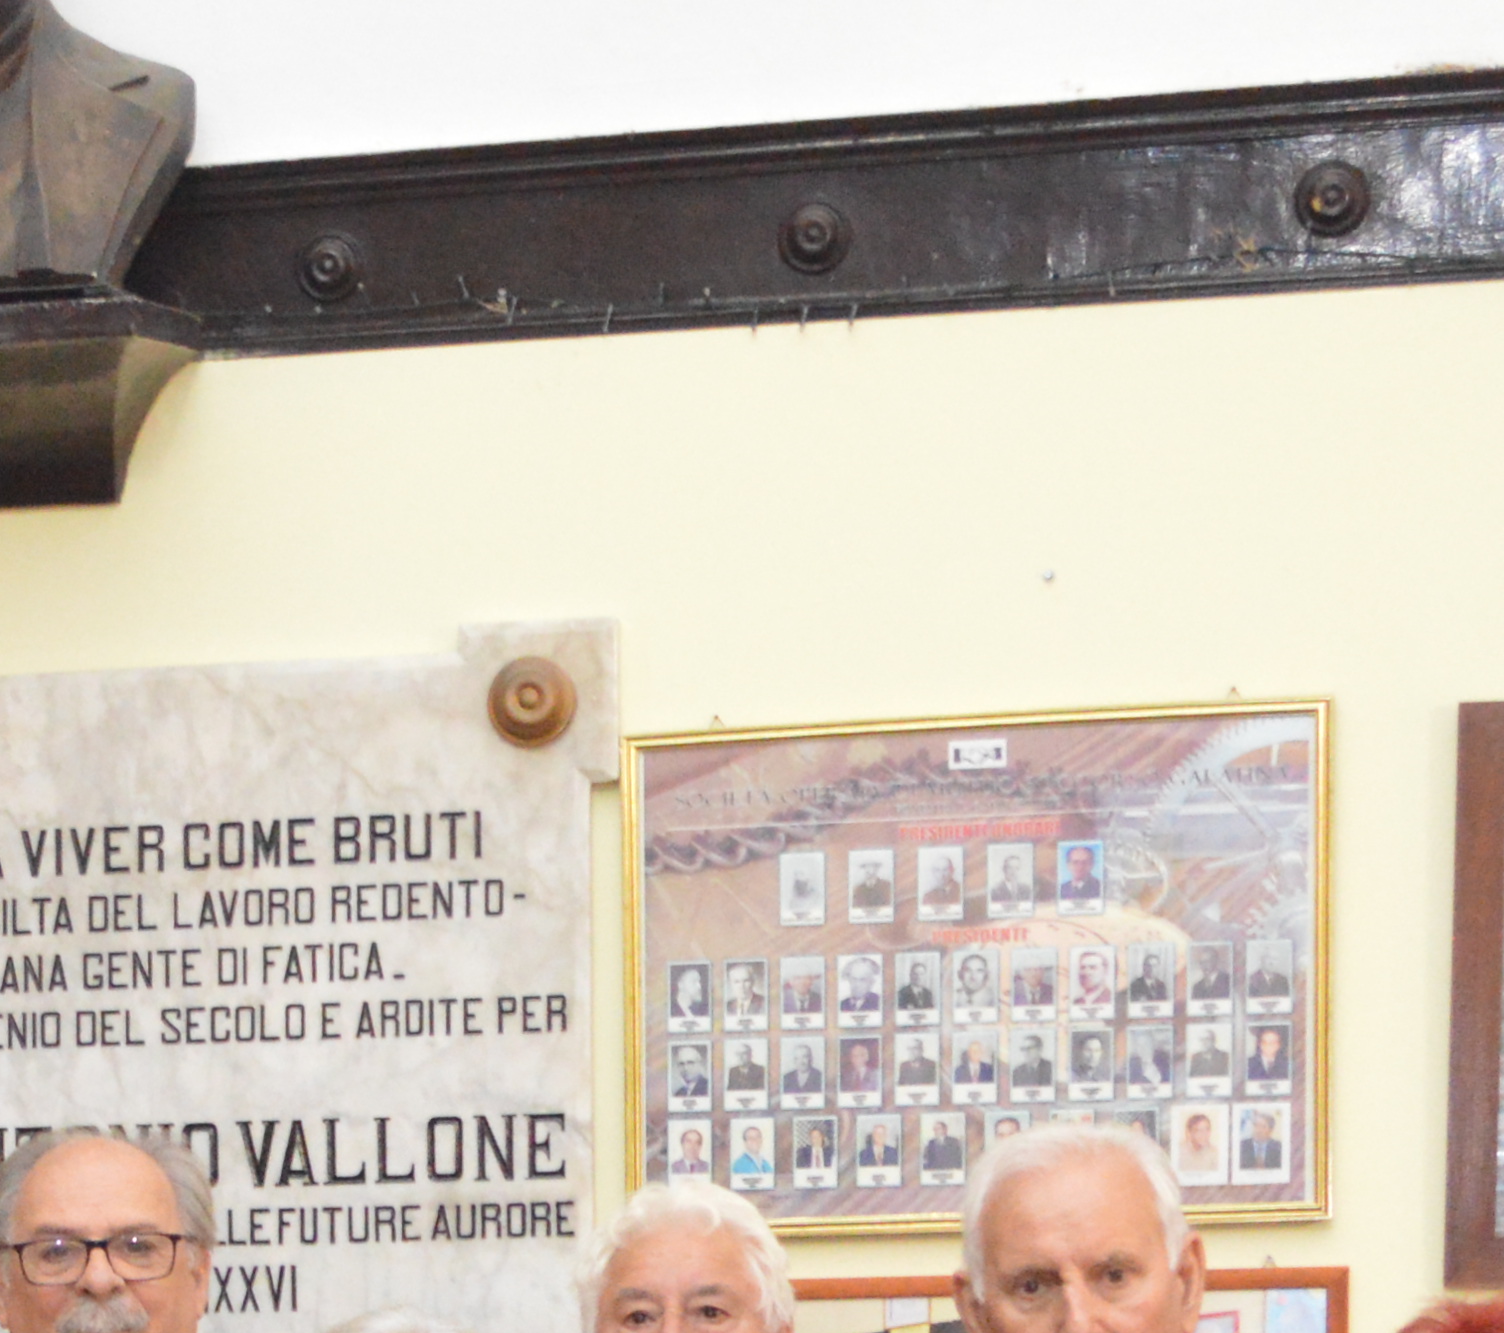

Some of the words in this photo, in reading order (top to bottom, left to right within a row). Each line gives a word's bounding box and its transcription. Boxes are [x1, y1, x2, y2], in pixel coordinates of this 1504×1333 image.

[21, 824, 166, 878] VIVER
[182, 817, 316, 871] COME
[332, 811, 484, 866] BRUTI
[88, 895, 158, 934] DEL
[173, 887, 316, 930] LAVORO
[82, 948, 202, 991] GENTE
[217, 947, 248, 986] DI
[76, 1009, 145, 1047] DEL
[160, 1004, 307, 1045] SECOLO
[321, 1003, 342, 1040] E
[356, 998, 483, 1039] ARDITE
[497, 994, 567, 1035] PER
[235, 1113, 567, 1188] VALLONE
[277, 1203, 421, 1246] FUTURE
[431, 1200, 576, 1240] AURORE
[204, 1264, 298, 1314] XXVI
